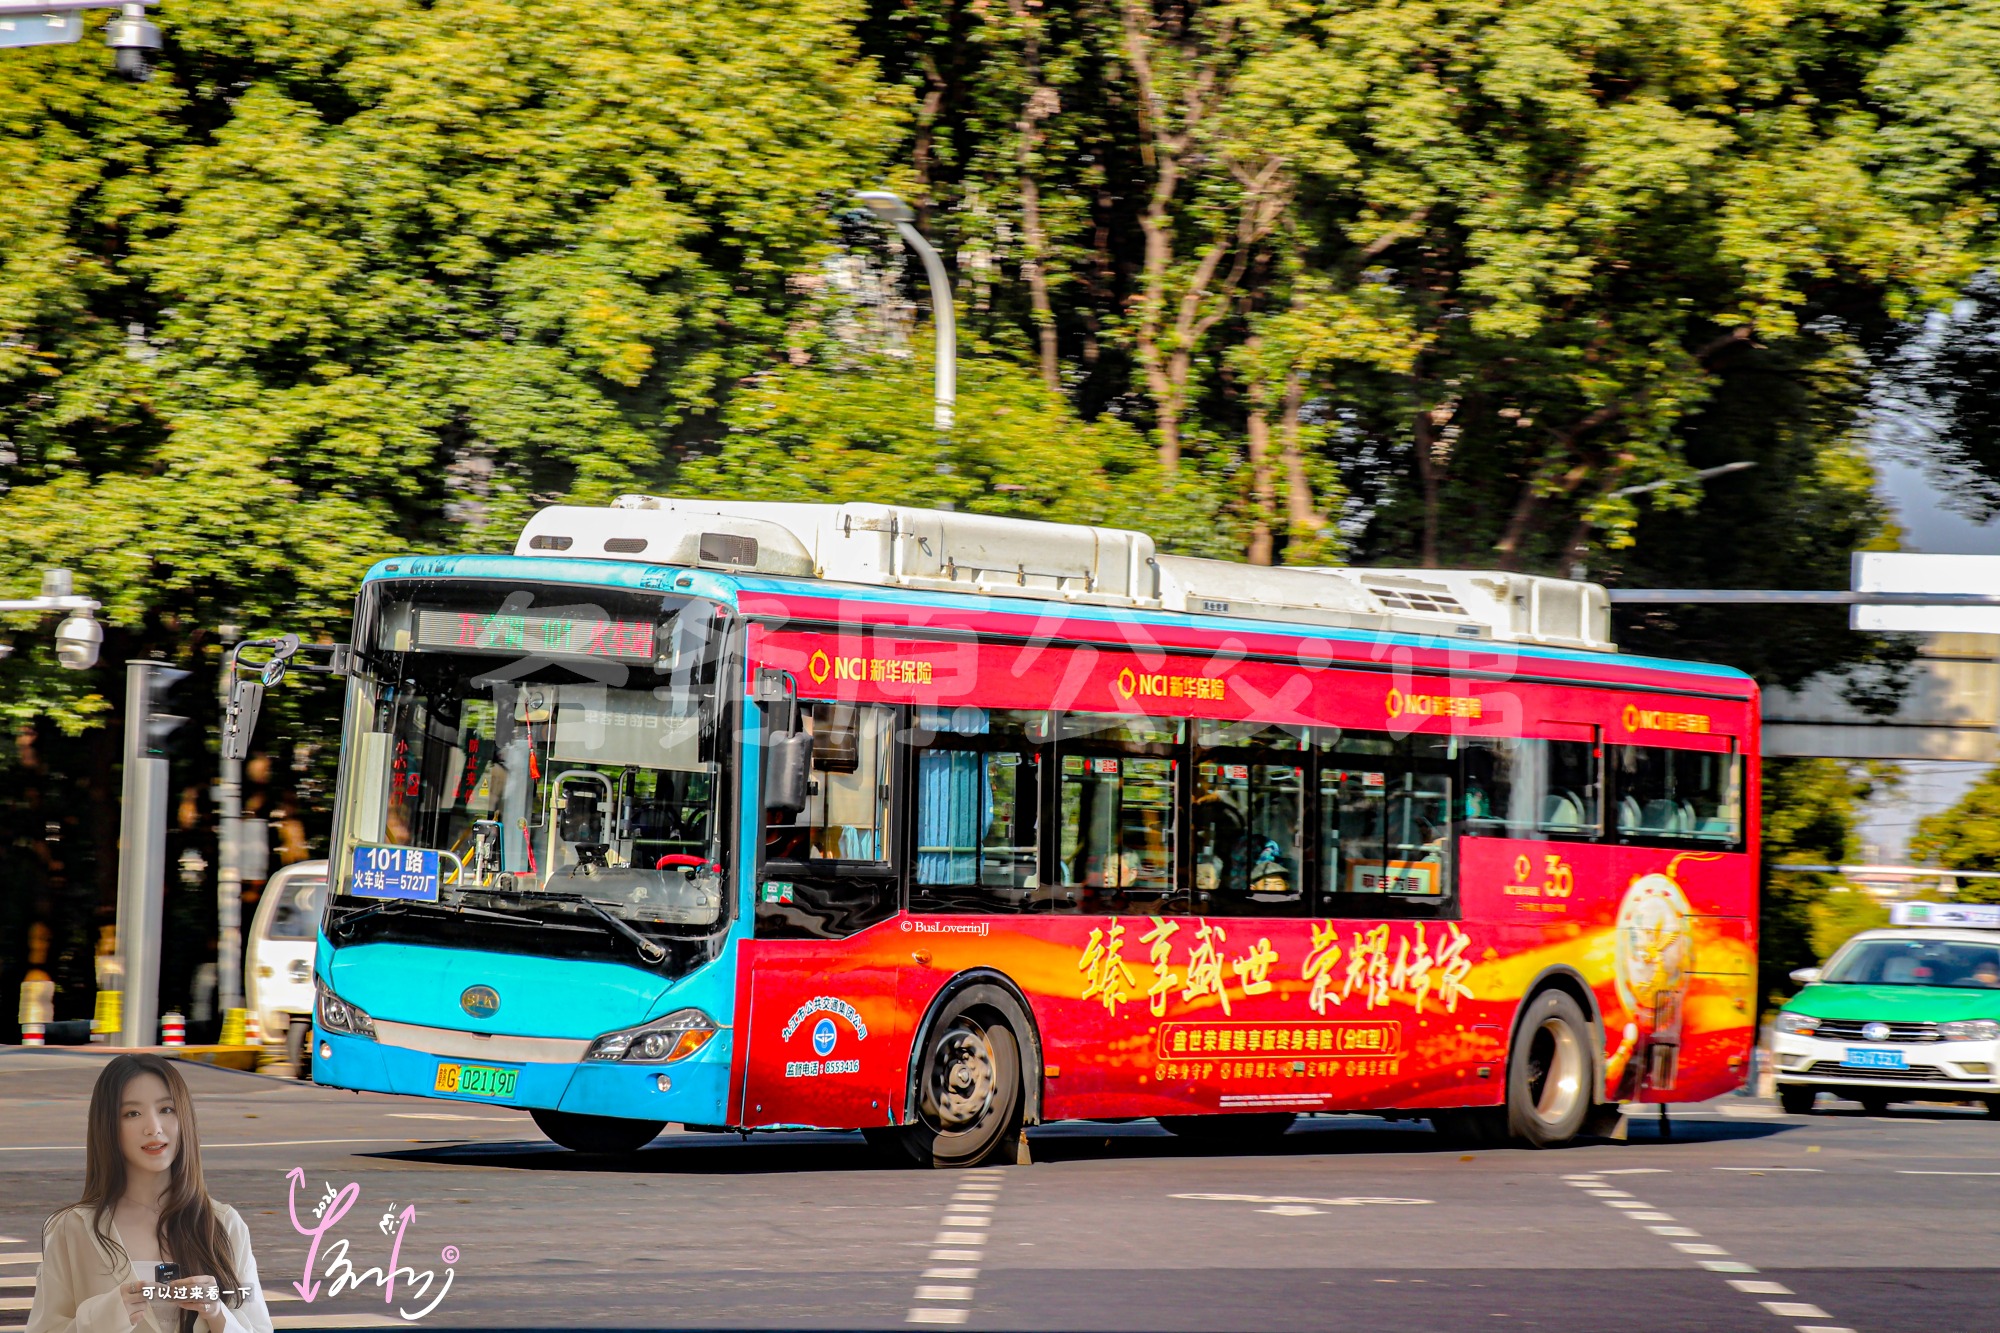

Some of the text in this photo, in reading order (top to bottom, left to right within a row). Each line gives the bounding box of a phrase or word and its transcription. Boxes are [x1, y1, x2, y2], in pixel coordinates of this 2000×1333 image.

[542, 619, 572, 652] 101
[586, 620, 655, 658] 火车站
[835, 656, 933, 685] NCI 新华保险
[1139, 673, 1225, 701] NCI 新华保险
[366, 847, 423, 874] 101路
[781, 995, 868, 1043] 九江市公共交通集团公司
